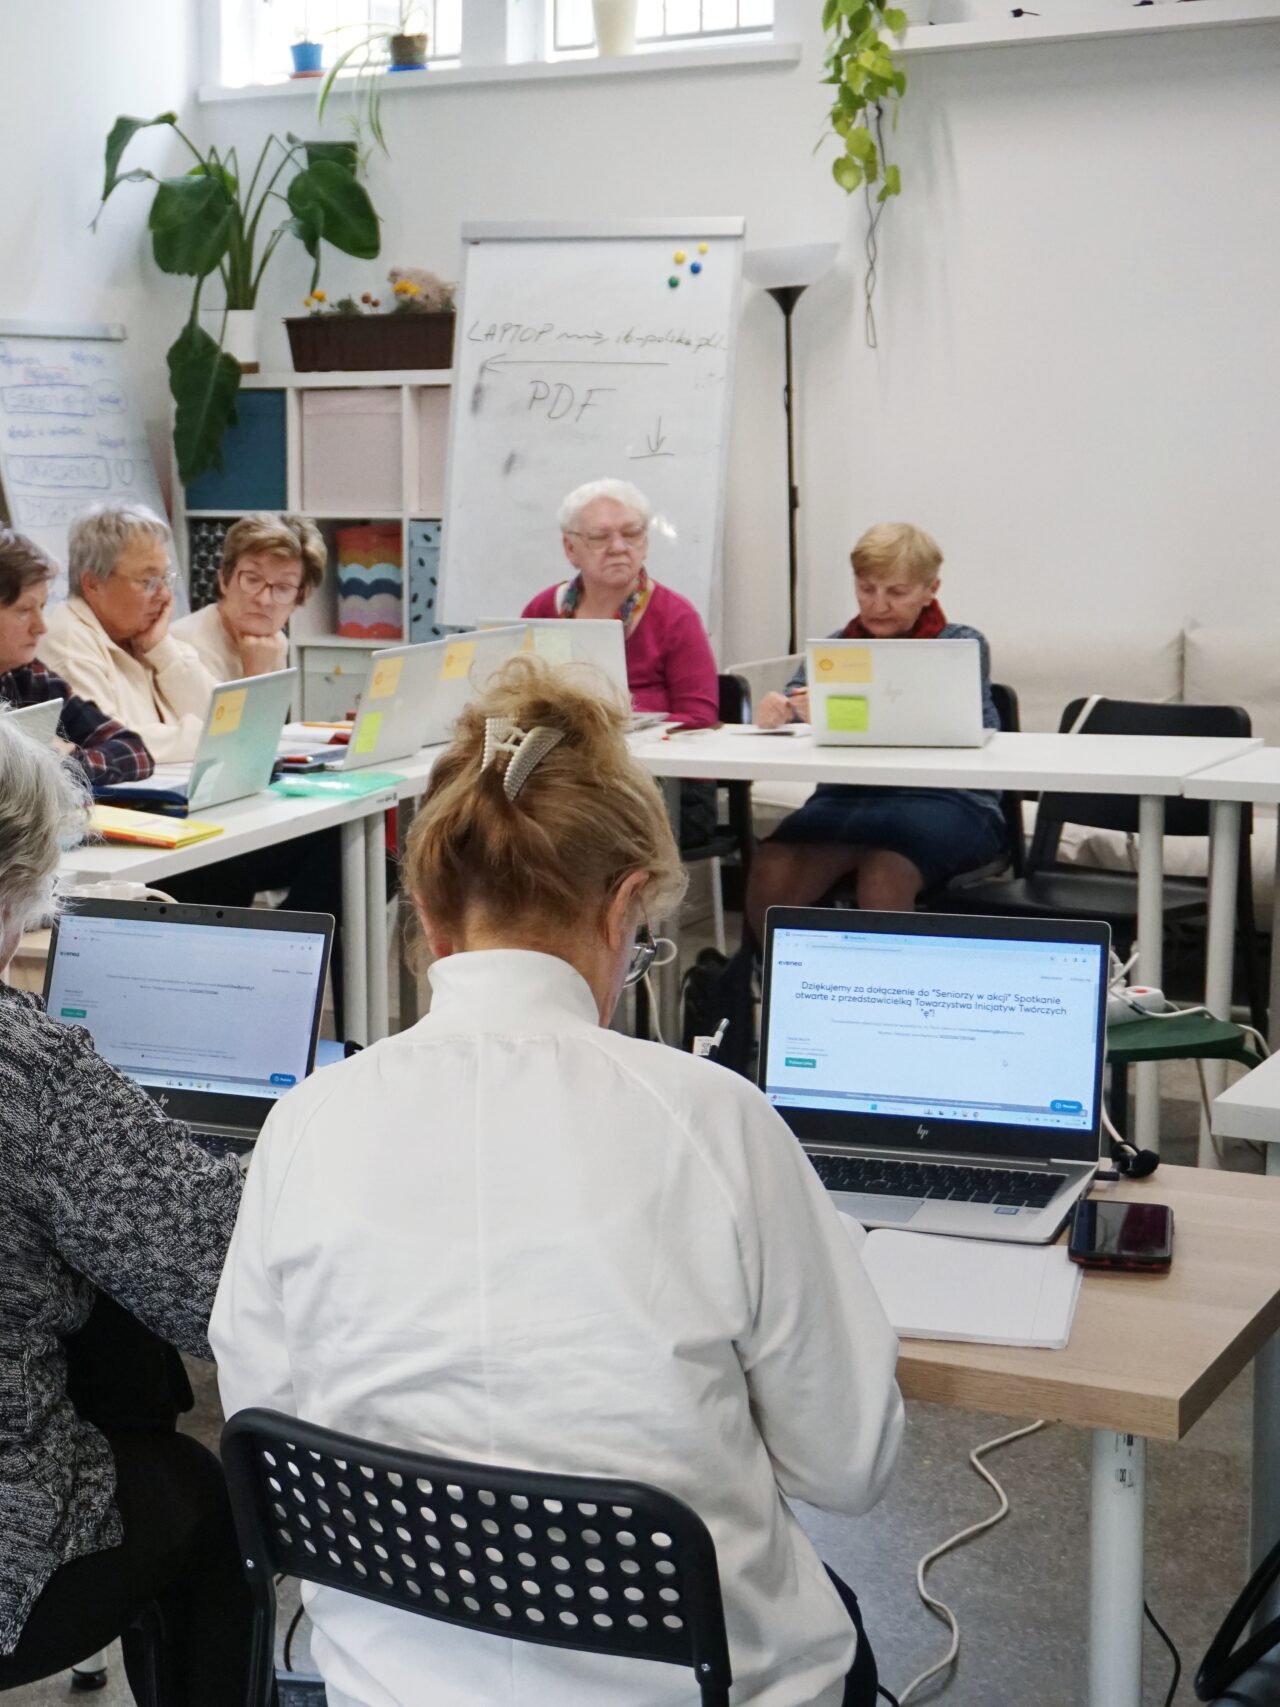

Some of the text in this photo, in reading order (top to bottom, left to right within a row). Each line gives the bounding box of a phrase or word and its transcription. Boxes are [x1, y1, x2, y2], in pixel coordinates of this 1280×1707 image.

[467, 320, 554, 343] LAPTOP
[527, 379, 617, 423] PDF
[795, 991, 829, 1001] otwarte
[838, 994, 912, 1007] przedstawicielką
[915, 997, 973, 1011] Towarzystwa
[975, 1001, 1016, 1013] Inicjatyw
[1019, 1004, 1067, 1016] Twórczych
[801, 981, 851, 994] Dziękujemy
[866, 986, 915, 996] dołączenie
[917, 988, 930, 997] do
[932, 988, 974, 1001] "Seniorzy
[987, 992, 1012, 1004] akcji"
[1014, 993, 1061, 1005] Spotkanie
[917, 1124, 928, 1140] hp
